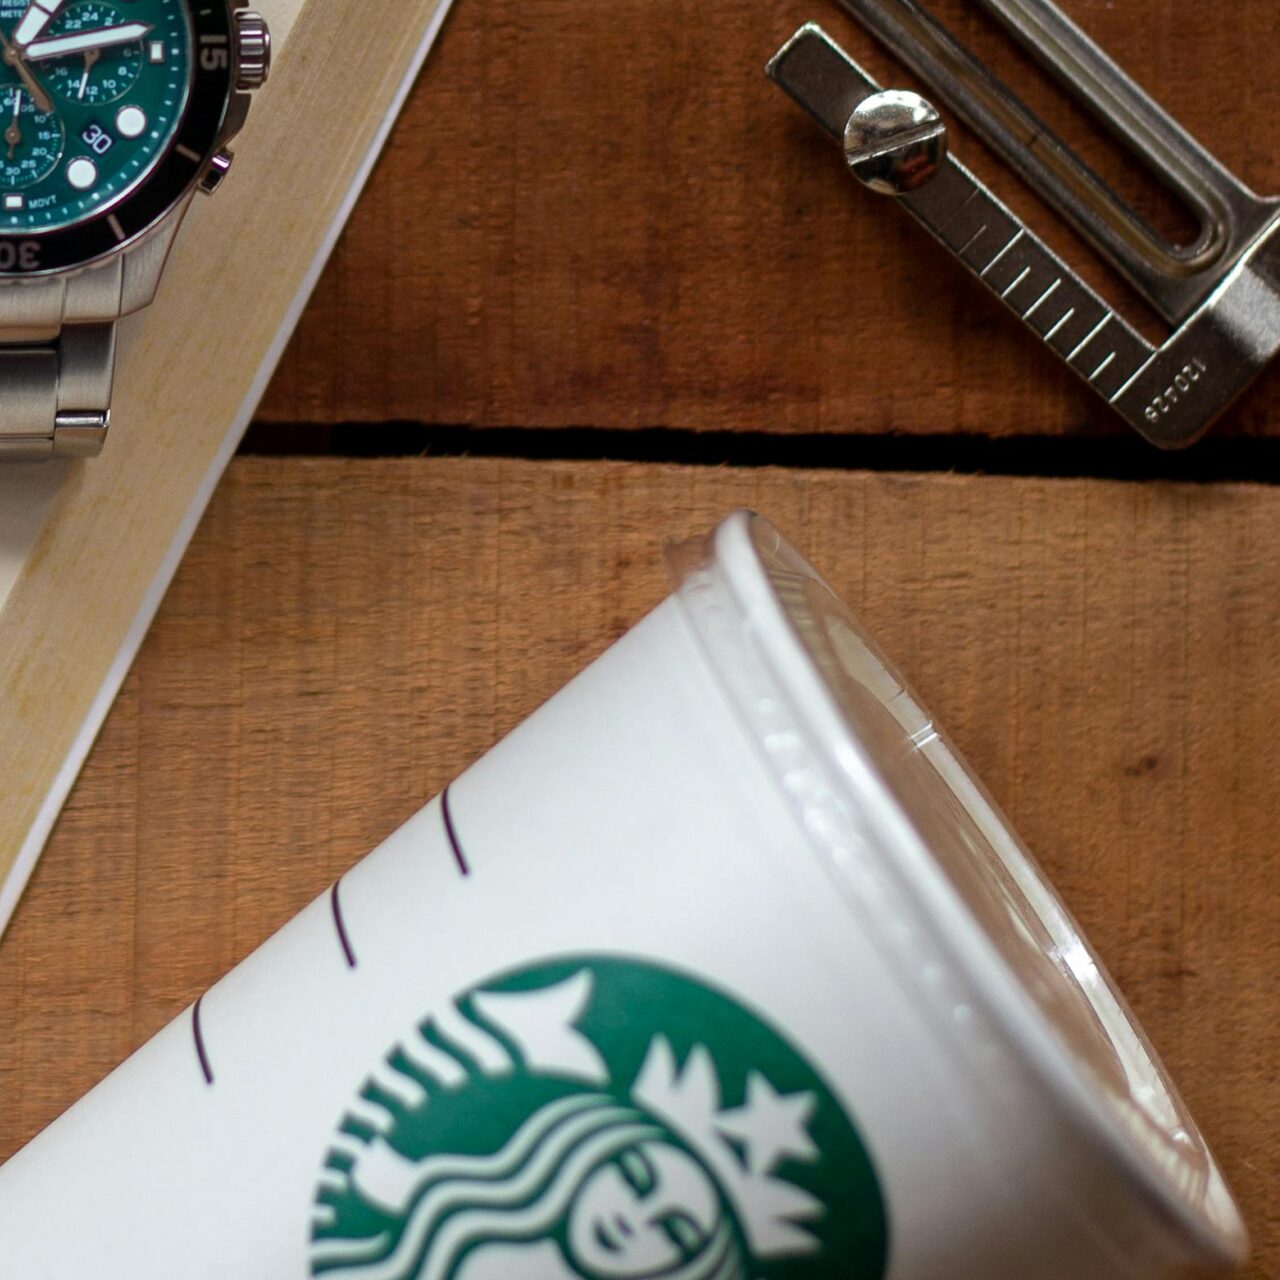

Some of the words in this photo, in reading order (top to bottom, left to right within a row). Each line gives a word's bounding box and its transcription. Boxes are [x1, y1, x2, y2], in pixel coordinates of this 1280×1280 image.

[82, 11, 99, 21] 24
[65, 19, 82, 29] 22
[199, 34, 228, 70] 15
[68, 80, 82, 89] 14
[103, 80, 117, 89] 10
[86, 86, 99, 95] 12
[34, 115, 47, 124] 10
[82, 124, 112, 154] 30
[5, 167, 20, 176] 30
[28, 195, 57, 209] MOVT
